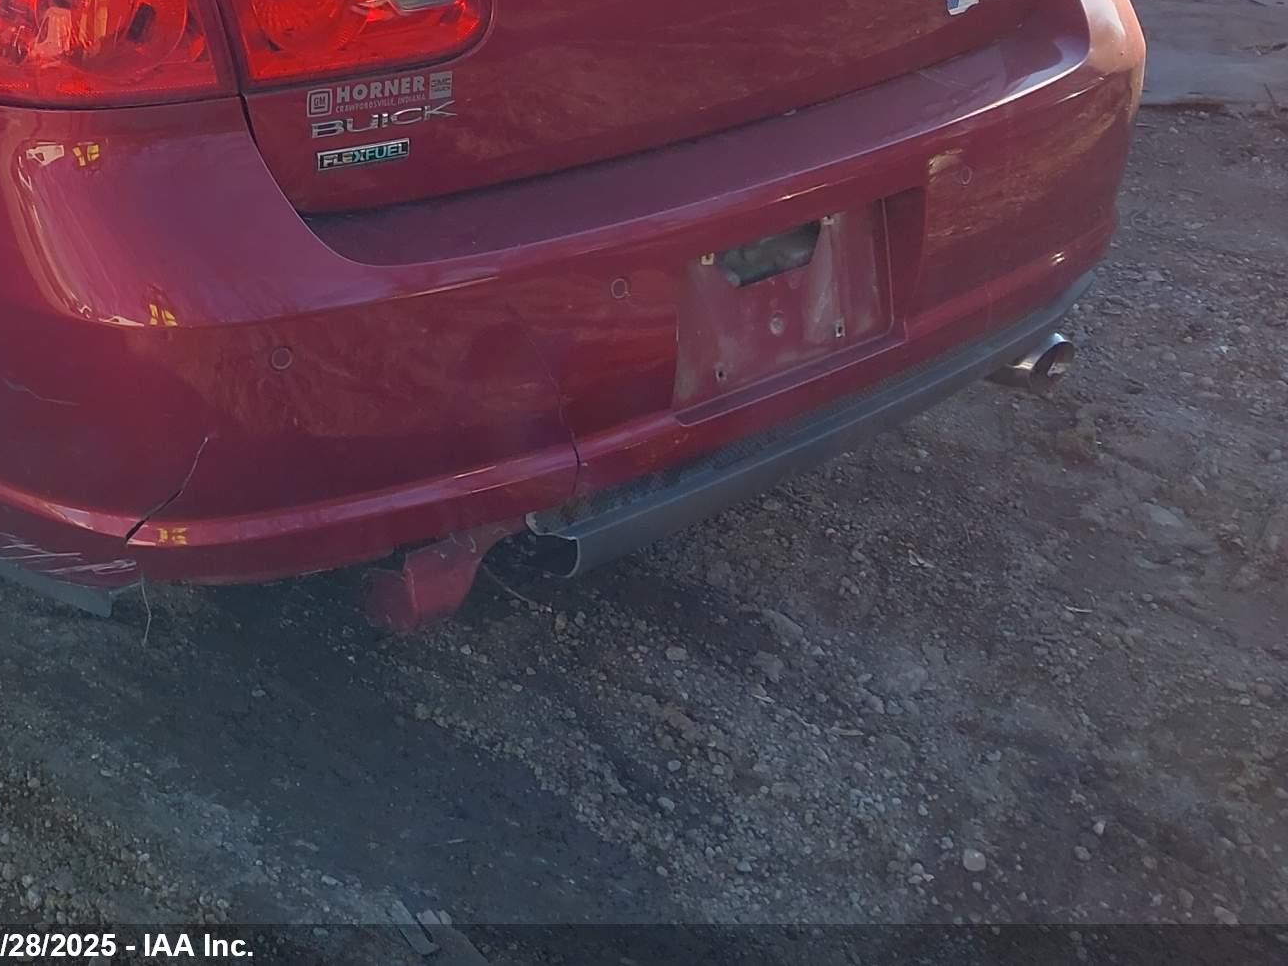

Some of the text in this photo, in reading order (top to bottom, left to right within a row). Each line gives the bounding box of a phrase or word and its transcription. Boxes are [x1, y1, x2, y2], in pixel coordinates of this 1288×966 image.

[336, 75, 425, 104] HORNER
[311, 99, 457, 139] BUICK
[322, 143, 408, 167] FLEXFUEL
